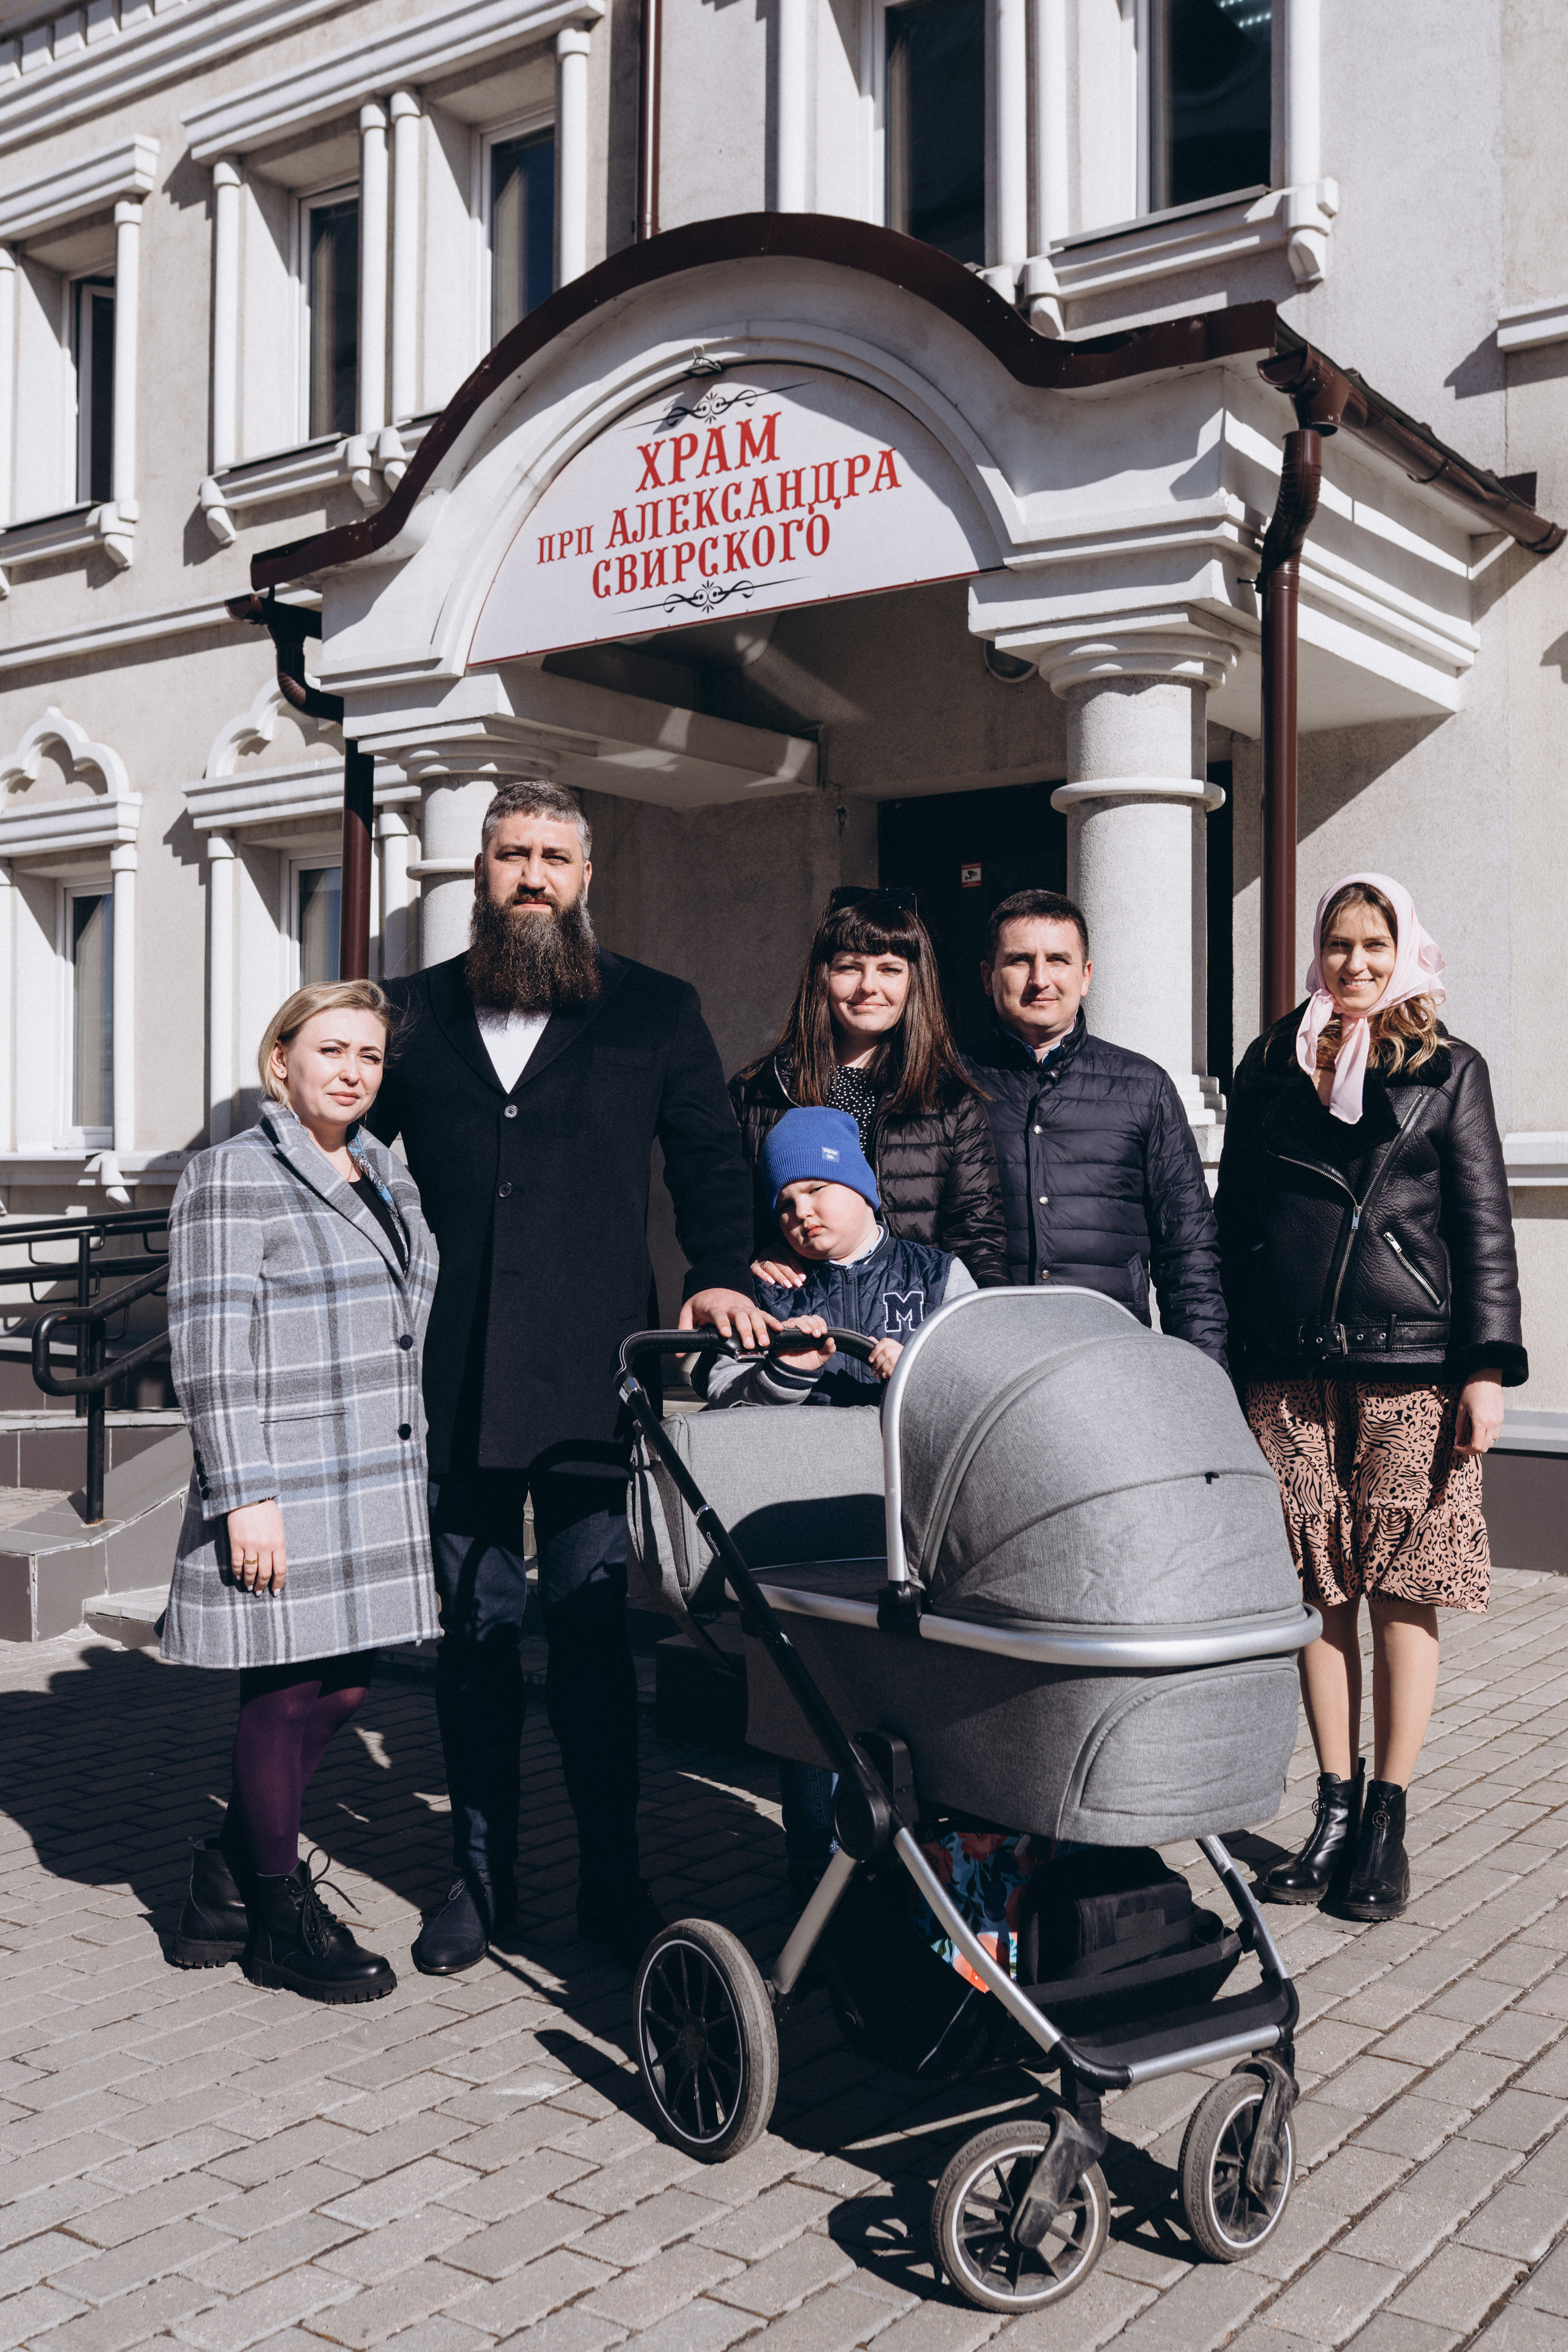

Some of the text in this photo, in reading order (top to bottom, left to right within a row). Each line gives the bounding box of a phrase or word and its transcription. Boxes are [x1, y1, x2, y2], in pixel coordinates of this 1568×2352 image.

[635, 412, 782, 493] ХРАМ
[537, 448, 902, 565] ПРП АЛЕКСАНДРА
[592, 514, 830, 598] СВИРСКОГО
[883, 1291, 924, 1333] M
[706, 1531, 721, 1557] Optima
